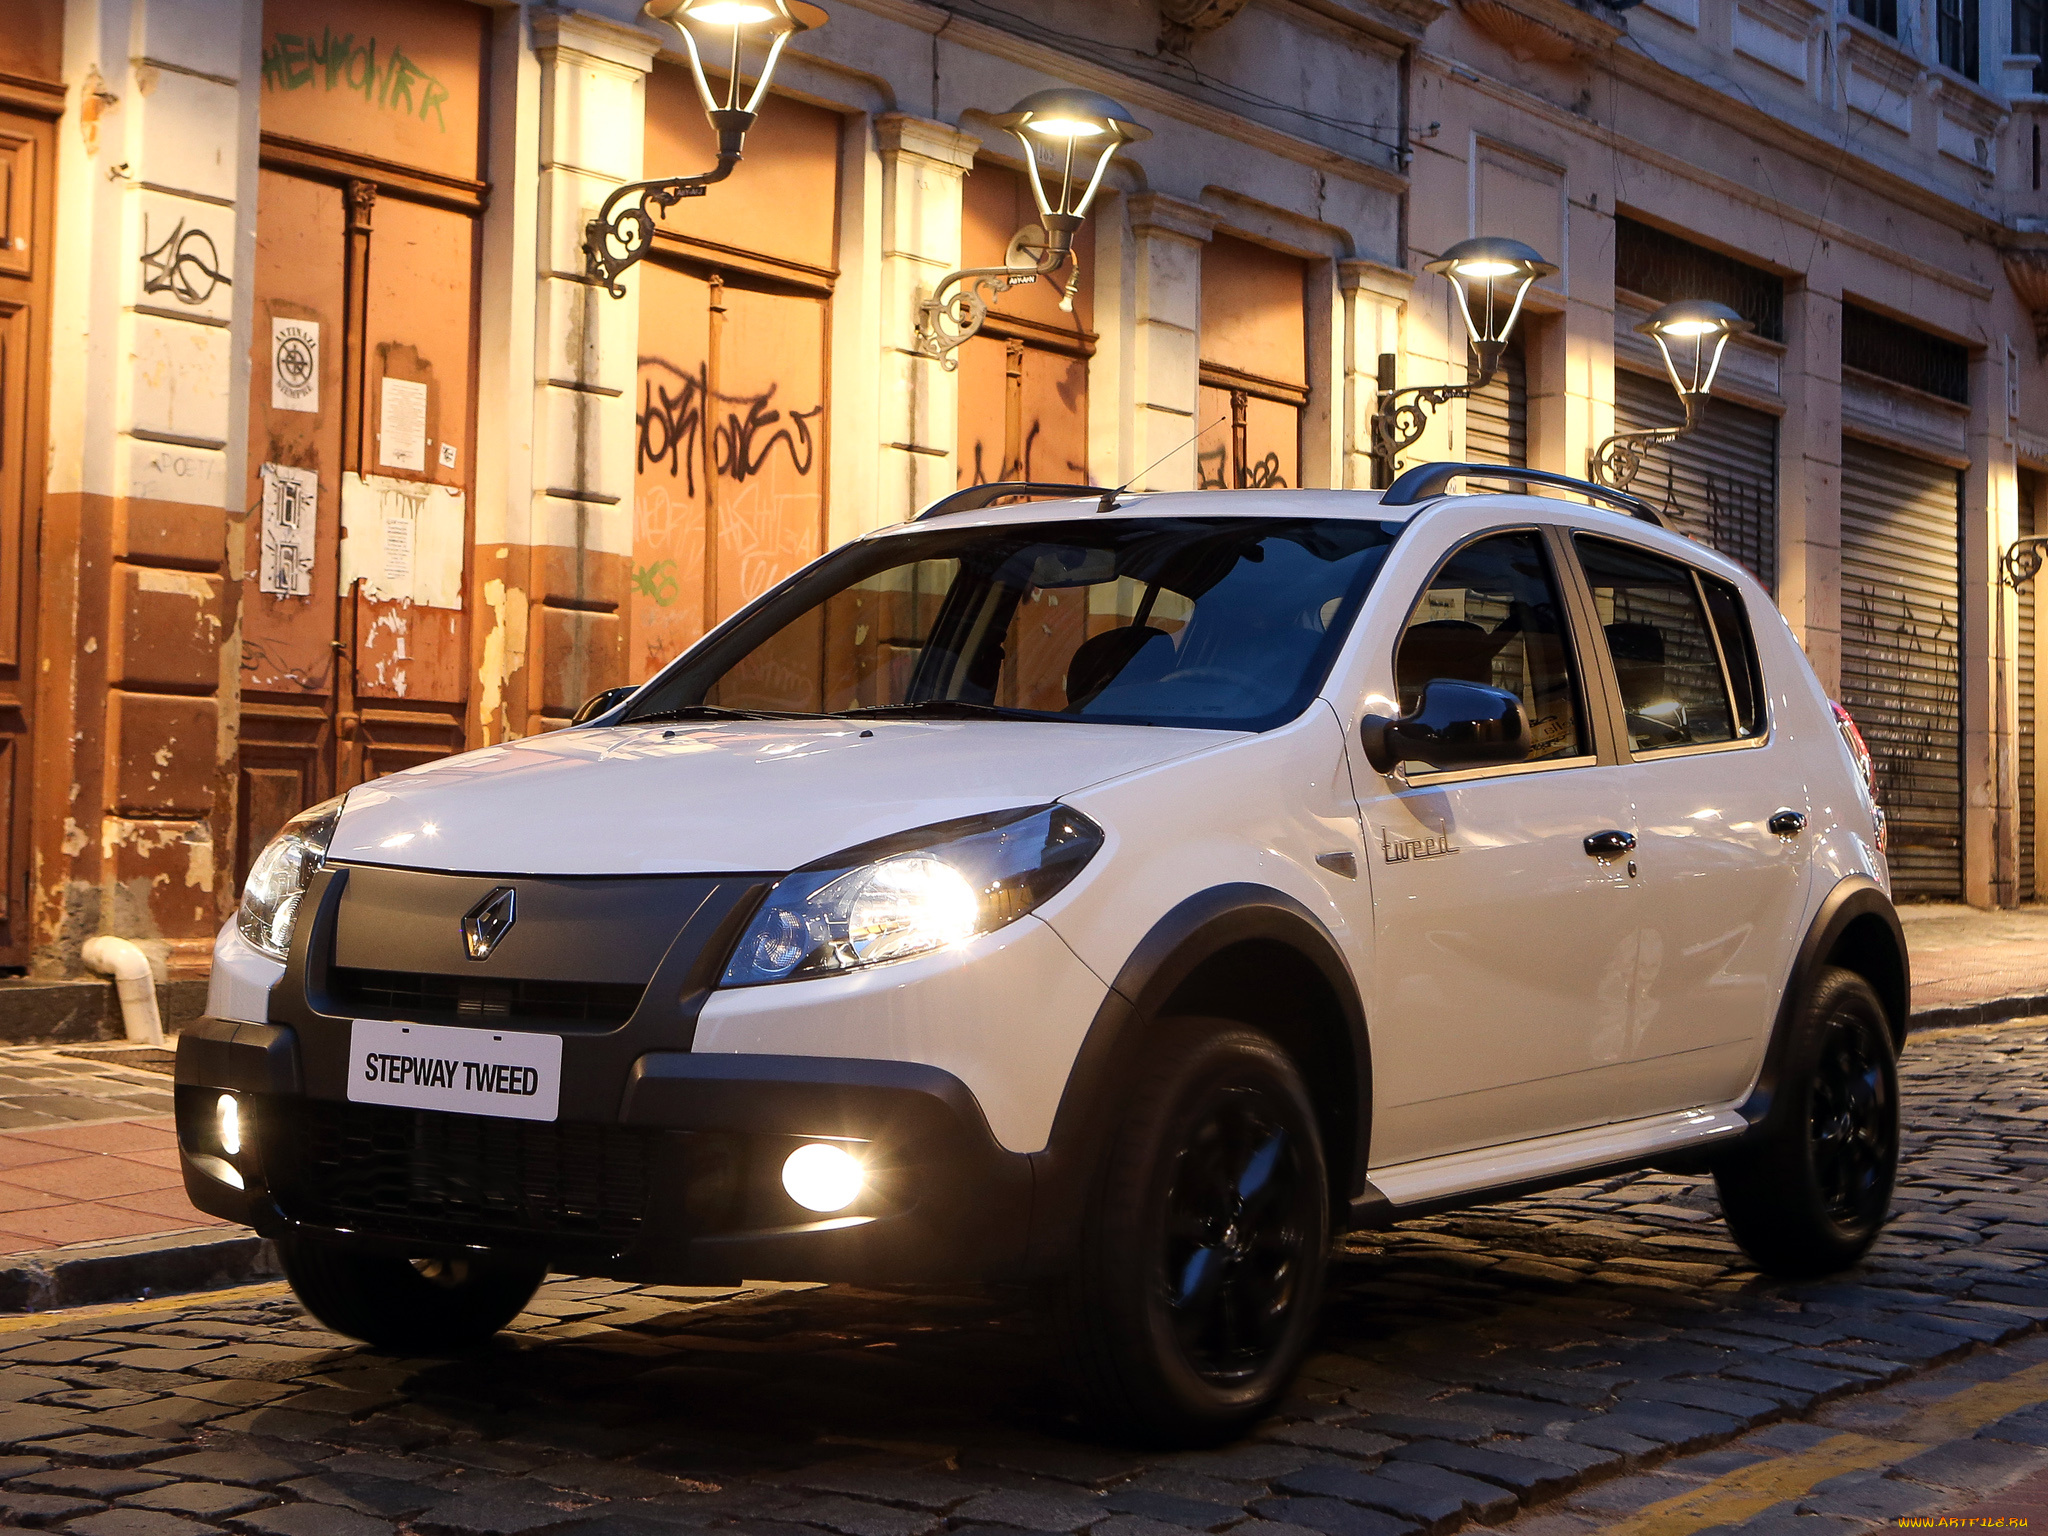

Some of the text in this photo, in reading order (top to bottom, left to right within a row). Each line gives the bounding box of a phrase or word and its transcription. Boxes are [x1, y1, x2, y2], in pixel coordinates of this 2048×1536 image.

[1381, 818, 1460, 864] tweed
[365, 1052, 539, 1096] STEPWAY TWEED
